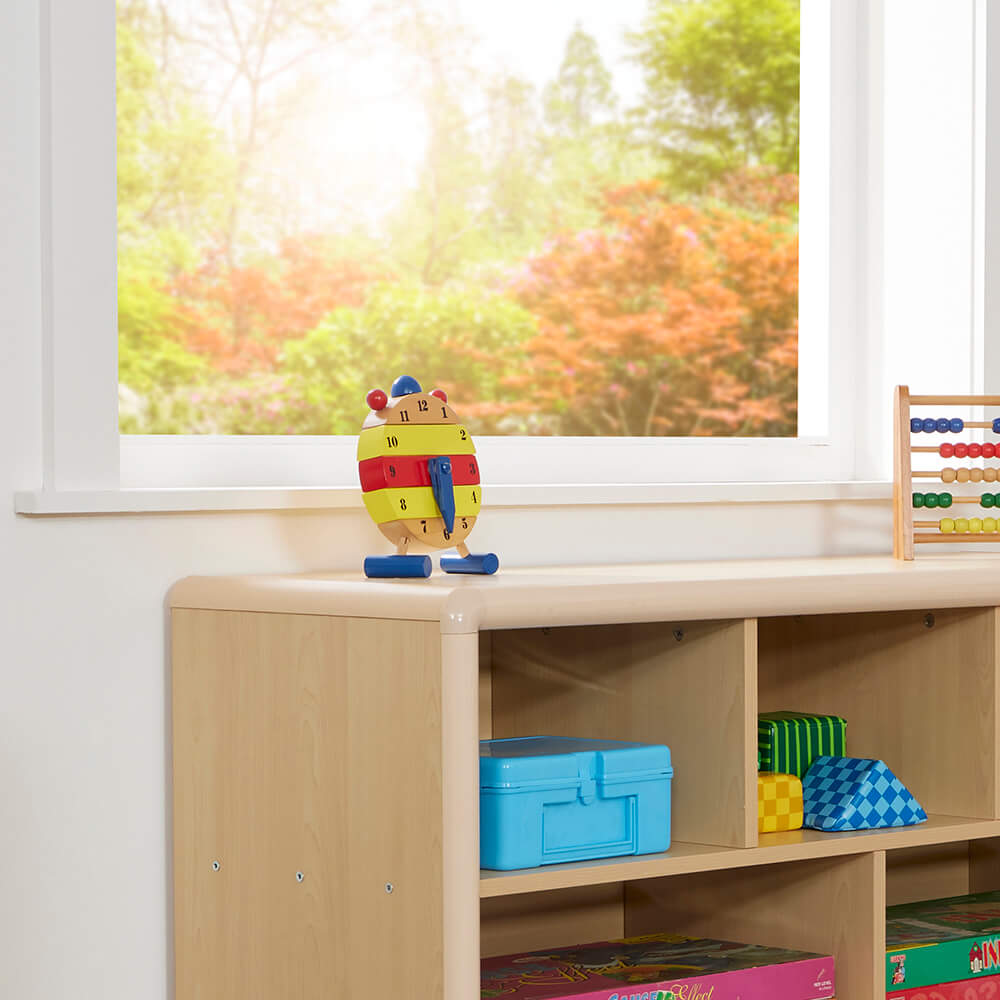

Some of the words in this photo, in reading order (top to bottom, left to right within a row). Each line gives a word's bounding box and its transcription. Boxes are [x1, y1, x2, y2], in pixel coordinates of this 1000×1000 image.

[417, 400, 429, 412] 12
[400, 410, 410, 422] 11
[441, 407, 448, 419] 1
[459, 429, 467, 440] 2
[387, 435, 399, 448] 10
[389, 464, 396, 478] 9
[469, 463, 476, 475] 3
[399, 498, 407, 511] 8
[420, 520, 427, 533] 7
[461, 517, 468, 529] 5
[443, 528, 450, 541] 6
